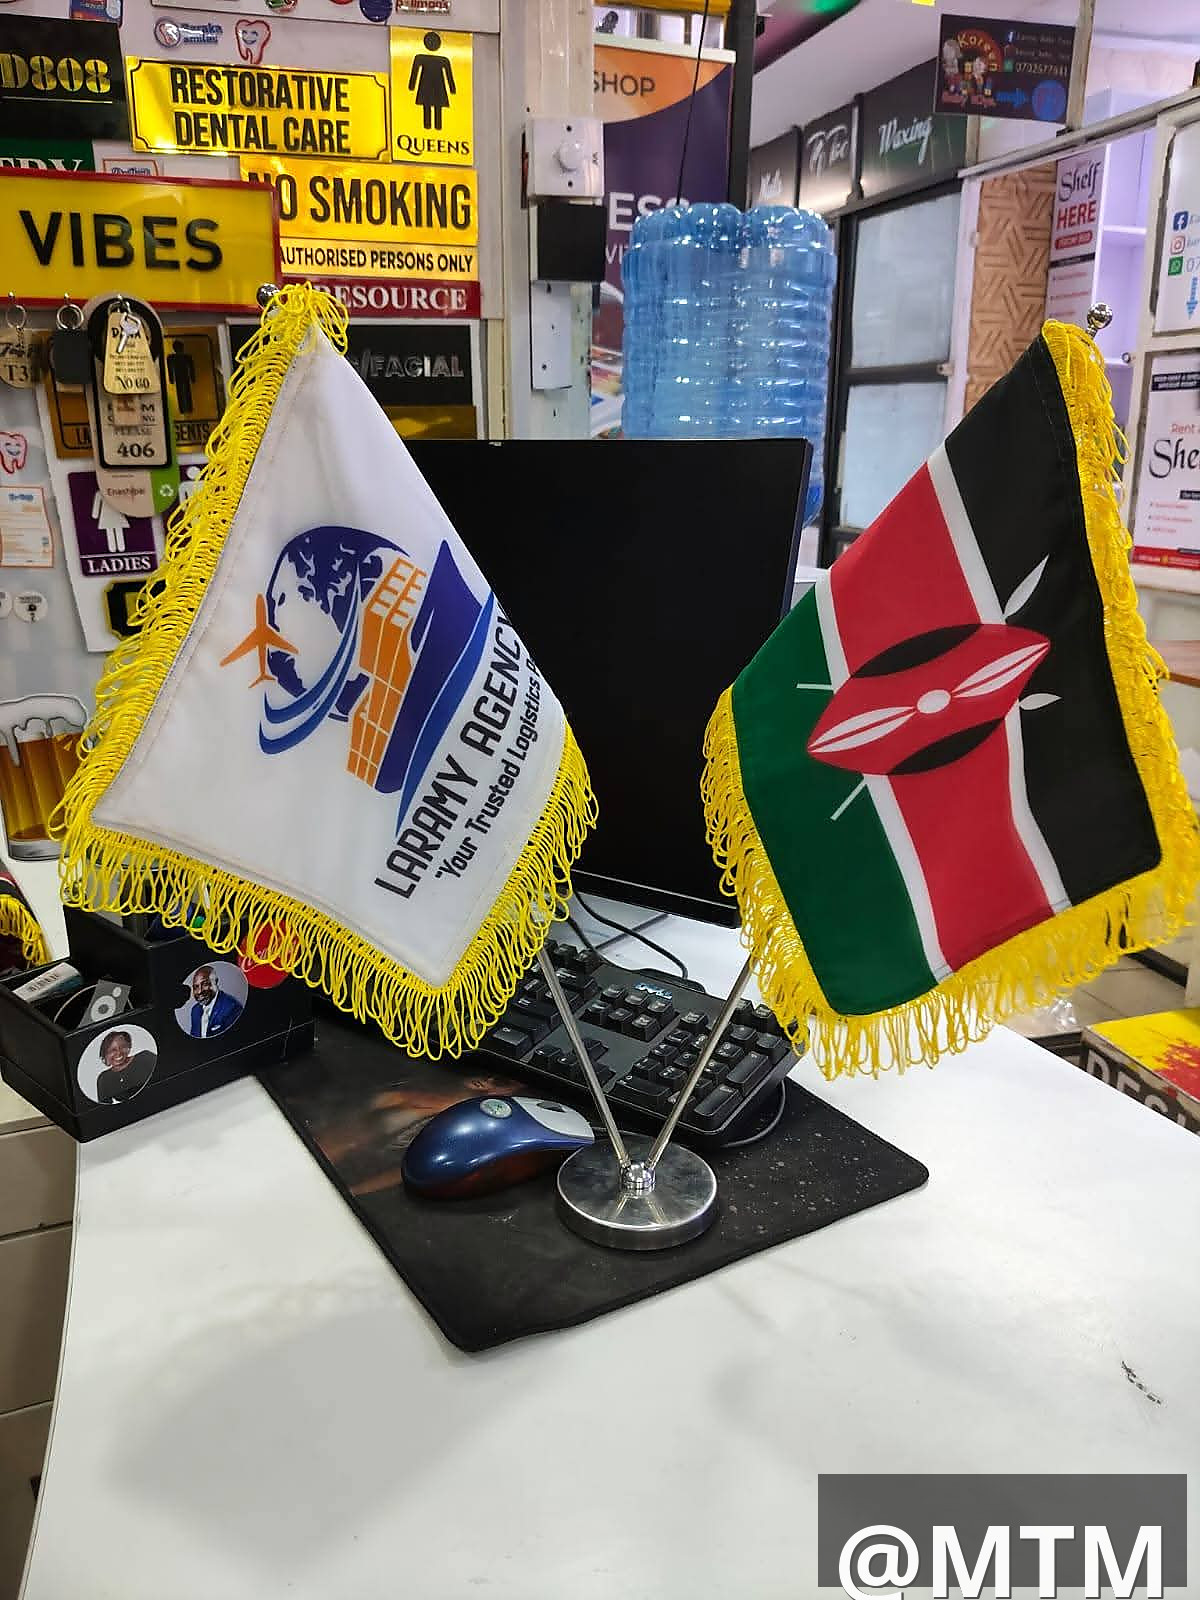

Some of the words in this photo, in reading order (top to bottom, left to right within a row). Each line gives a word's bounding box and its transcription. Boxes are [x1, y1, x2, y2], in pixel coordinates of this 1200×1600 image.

[170, 66, 350, 113] RESTORATIVE
[174, 111, 275, 152] DENTAL
[282, 117, 351, 154] CARE
[397, 134, 470, 156] QUEENS
[878, 116, 932, 165] Waxing
[1058, 159, 1101, 202] Shelf
[249, 172, 297, 222] O
[310, 176, 472, 229] SMOKING
[1056, 200, 1097, 230] HERE
[19, 210, 224, 270] VIBES
[605, 244, 629, 264] VI
[370, 249, 435, 271] PERSONS
[437, 253, 474, 273] ONLY
[352, 349, 466, 380] /FACIAL
[1171, 422, 1194, 434] Rent
[117, 442, 155, 458] 406
[88, 556, 151, 574] LADIES
[464, 757, 521, 836] Trusted
[507, 678, 542, 766] Logistics
[374, 754, 479, 900] LARAMY
